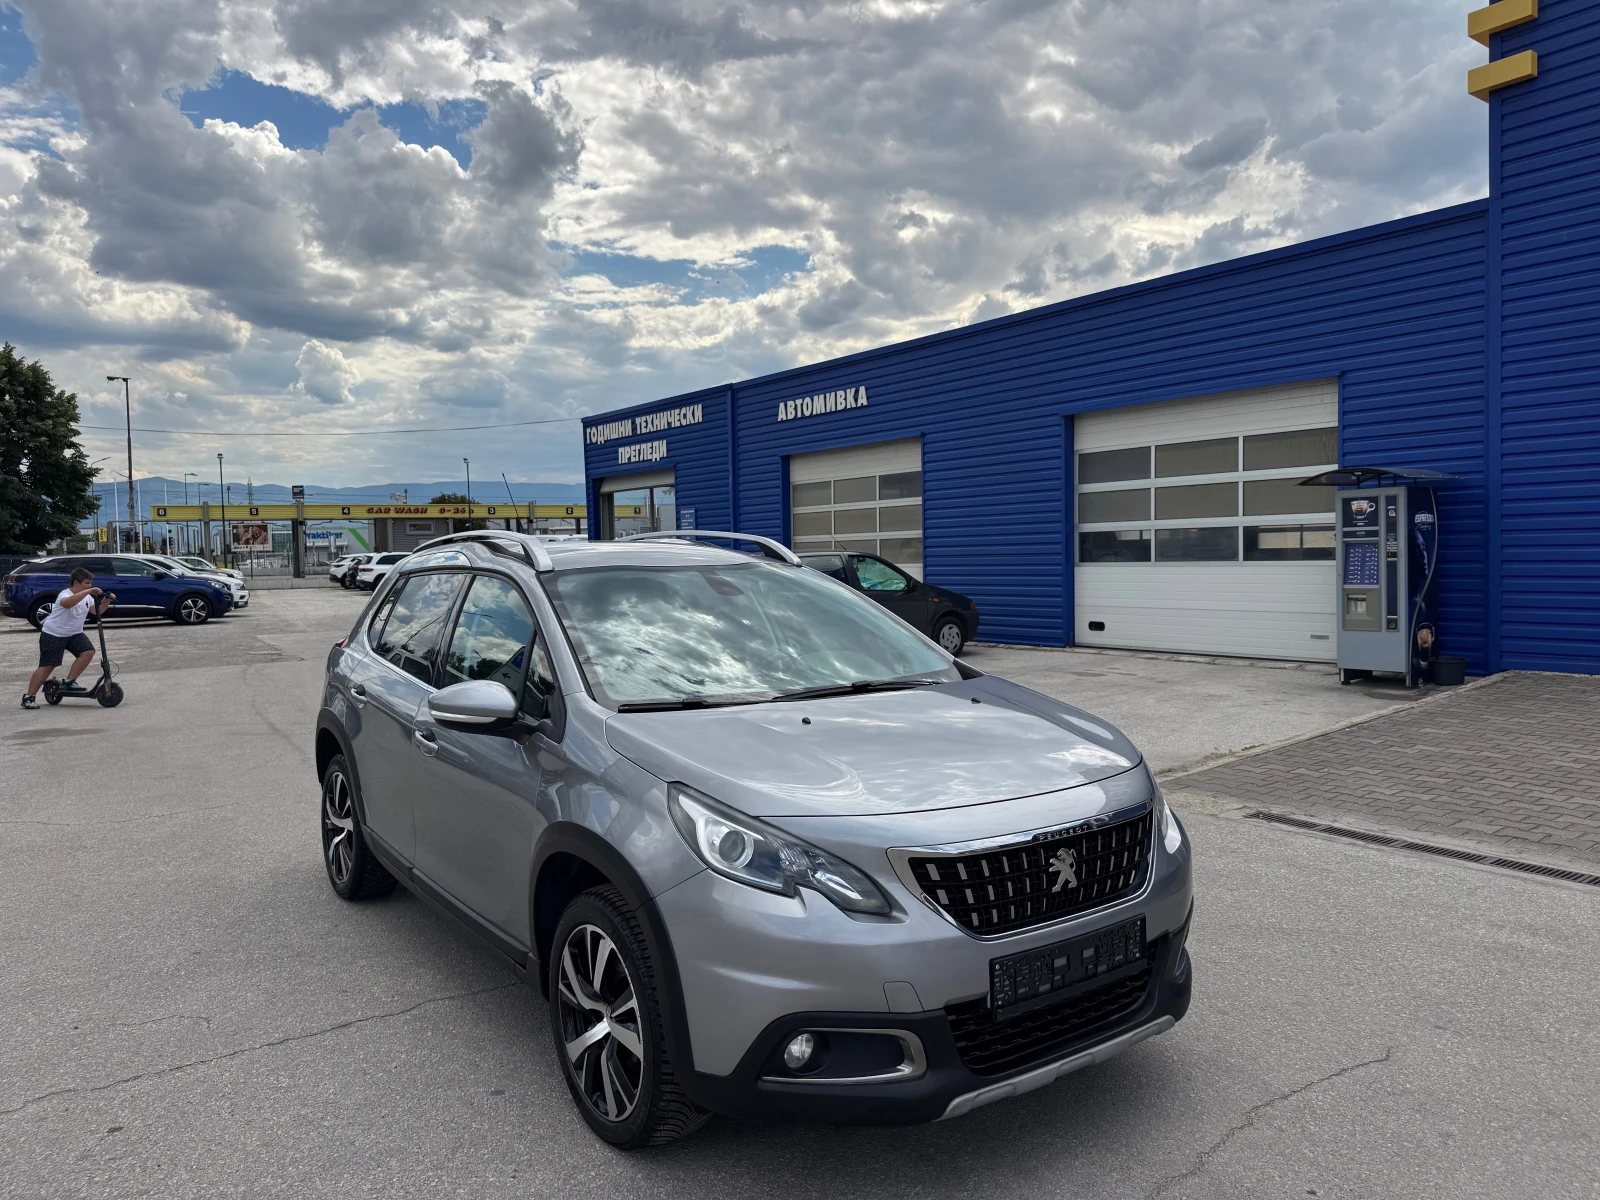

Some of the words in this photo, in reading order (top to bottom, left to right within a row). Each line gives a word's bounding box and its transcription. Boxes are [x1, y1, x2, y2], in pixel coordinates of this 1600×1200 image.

[777, 385, 868, 422] АВТОМИВКА
[586, 419, 632, 445] ГОДИШНИ
[635, 403, 703, 435] ТЕХНИЧЕСКИ
[618, 440, 667, 464] ПРЕГЛЕДИ
[305, 531, 343, 539] raktiker
[1039, 825, 1088, 841] PEUGEOT
